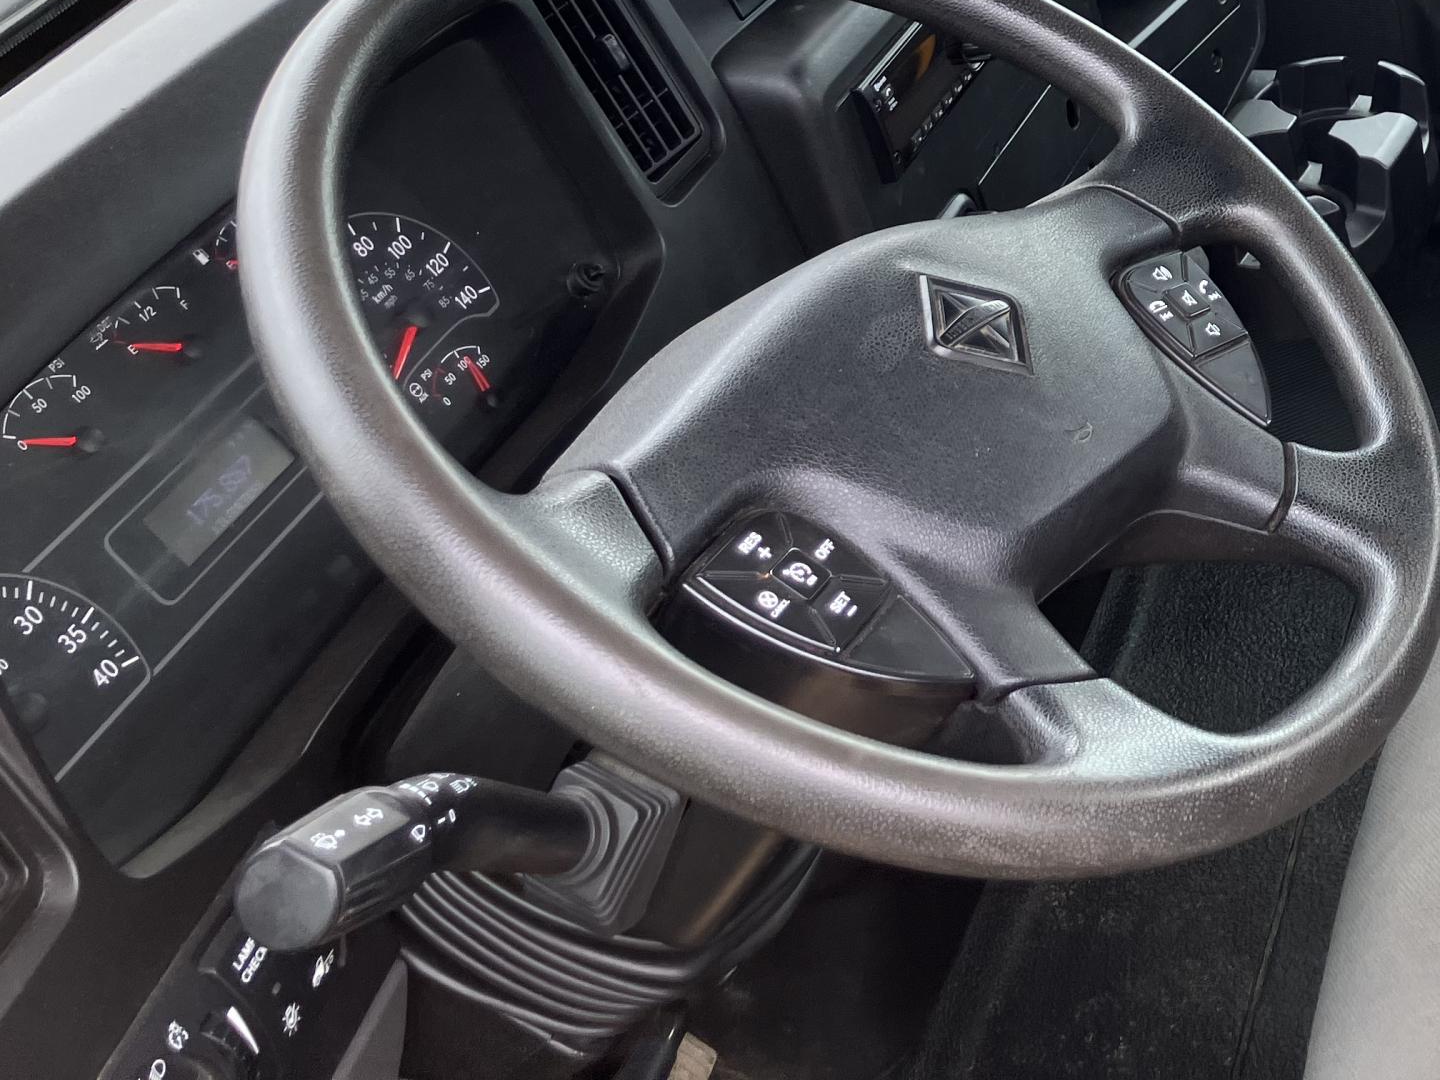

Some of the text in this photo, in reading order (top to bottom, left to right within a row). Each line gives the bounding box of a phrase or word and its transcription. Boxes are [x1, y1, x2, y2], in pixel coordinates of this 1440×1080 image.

[353, 236, 375, 257] 80
[387, 235, 413, 260] 100
[384, 267, 396, 279] 55
[425, 253, 450, 277] 120
[367, 273, 379, 285] 45
[404, 268, 416, 281] 65
[423, 279, 436, 291] 75
[372, 283, 394, 304] km/h
[438, 295, 451, 308] 85
[454, 285, 479, 309] 140
[180, 299, 188, 310] F
[139, 306, 157, 322] 1/2
[127, 344, 139, 355] E
[48, 357, 65, 373] PSI
[476, 354, 490, 369] 150
[420, 368, 433, 382] PSI
[444, 372, 456, 385] 50
[71, 385, 91, 403] 100
[442, 397, 451, 406] 0
[31, 398, 47, 413] 50
[17, 440, 28, 450] 0
[738, 531, 762, 554] RES
[814, 538, 835, 560] OFF
[829, 591, 851, 614] SET
[13, 606, 43, 635] 30
[58, 624, 87, 653] 35
[93, 659, 119, 686] 40
